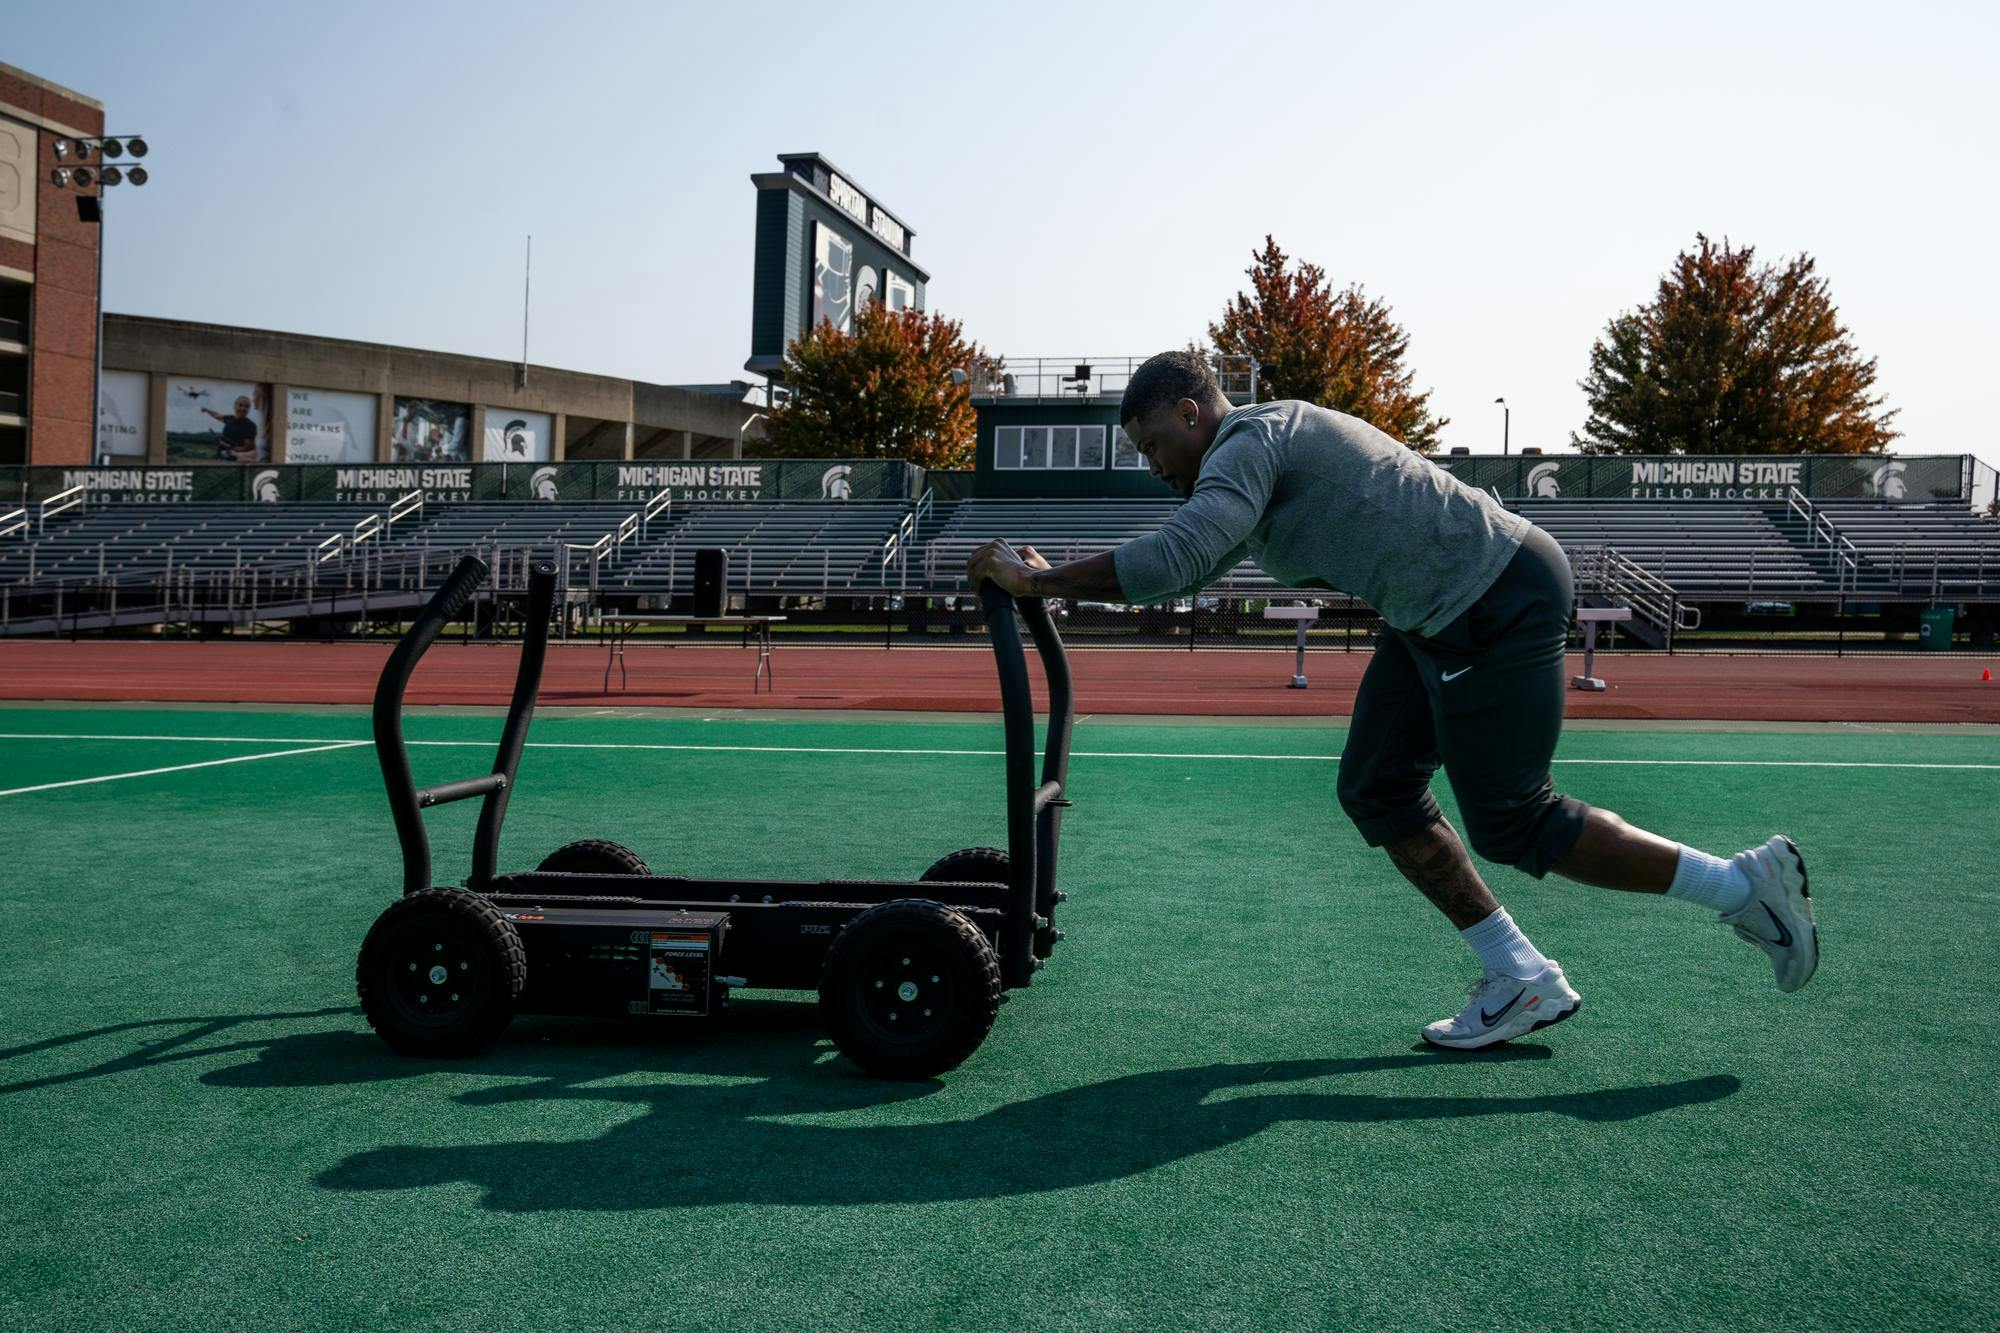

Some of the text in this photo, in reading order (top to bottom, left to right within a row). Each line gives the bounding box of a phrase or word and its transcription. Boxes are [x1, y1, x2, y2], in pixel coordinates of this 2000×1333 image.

[292, 391, 309, 401] WE
[292, 407, 313, 416] ARE
[287, 422, 341, 433] SPARTANS
[291, 438, 305, 446] OF
[617, 466, 762, 486] MICHIGAN STATE
[1631, 462, 1802, 484] MICHIGAN STATE
[63, 471, 194, 490] MICHIGAN STATE
[336, 468, 473, 489] MICHIGAN STATE
[122, 493, 193, 503] HOCKEY
[336, 492, 386, 502] FIELD
[684, 490, 760, 500] HOCKEY
[1632, 488, 1693, 500] FIELD
